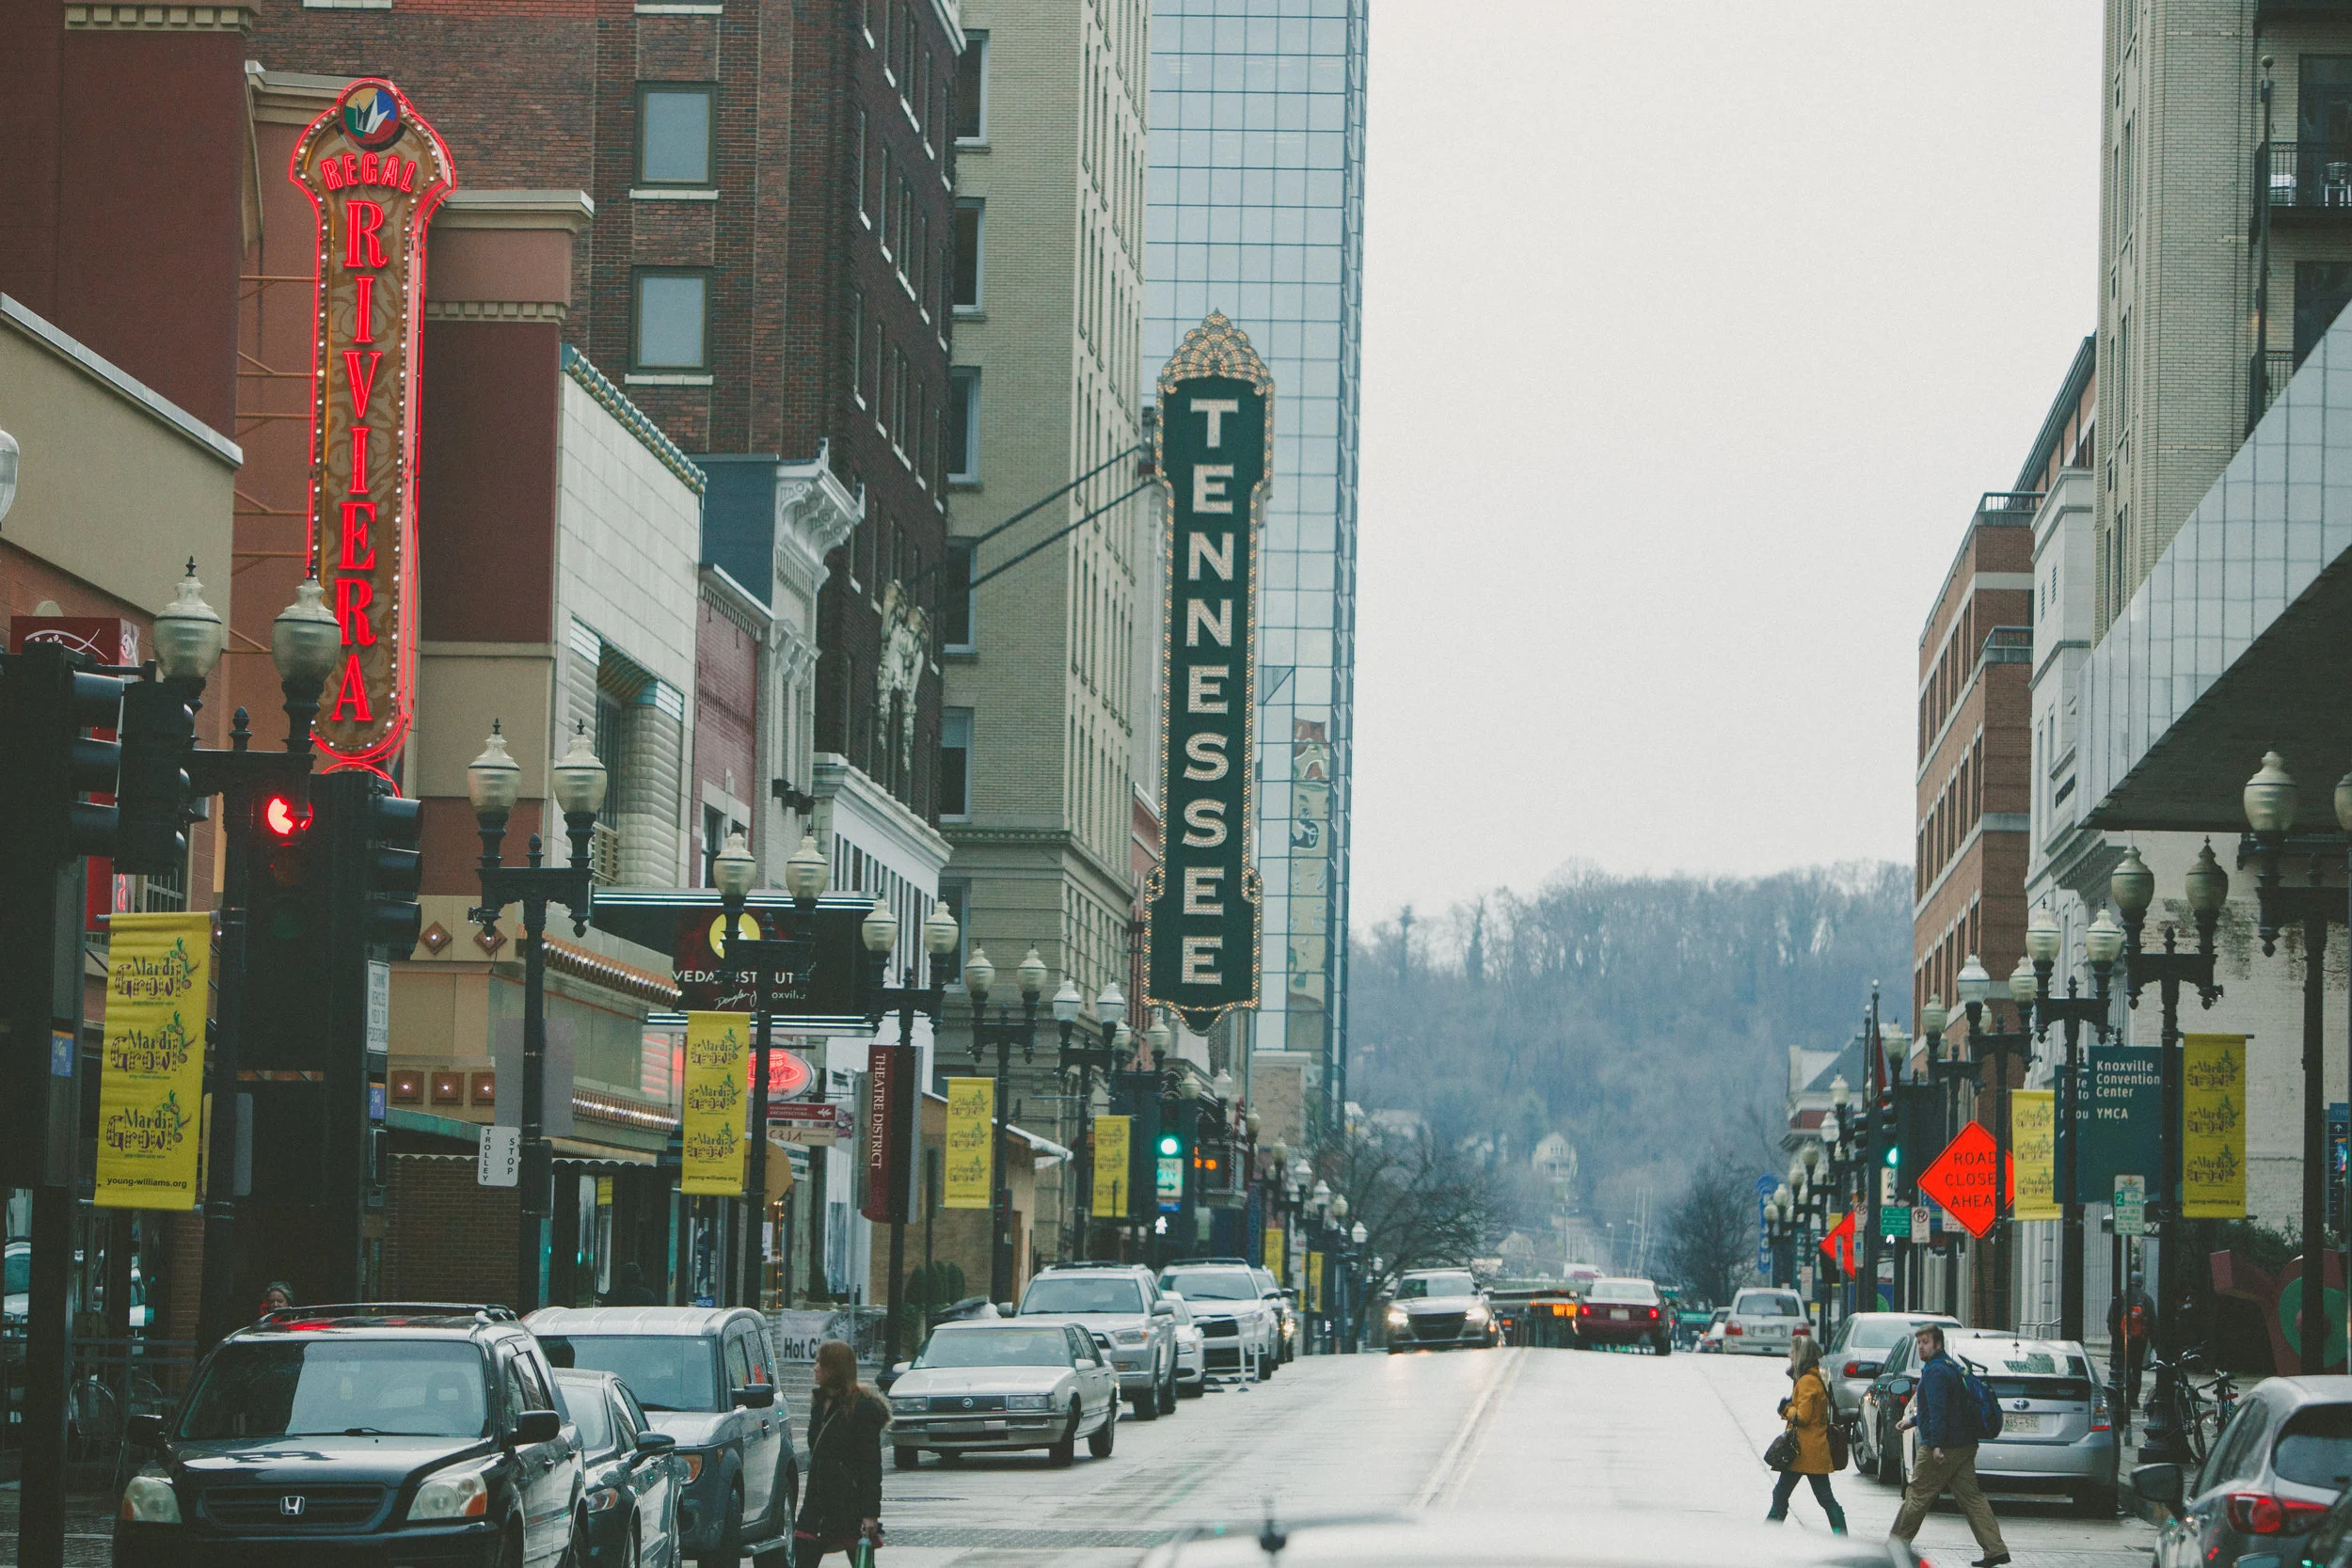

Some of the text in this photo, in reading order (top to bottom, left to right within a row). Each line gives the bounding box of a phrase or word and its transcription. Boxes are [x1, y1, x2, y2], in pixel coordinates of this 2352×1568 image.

[320, 152, 417, 193] REGAL
[331, 199, 389, 721] RIVIERA
[1182, 398, 1239, 986] TENNESSEE
[133, 956, 175, 976] Mardi
[673, 970, 716, 983] VEDA
[128, 1028, 171, 1050] Mardi
[2096, 1060, 2153, 1072] Knoxville
[2096, 1073, 2161, 1085] Convention
[2096, 1086, 2134, 1098] Center
[871, 1053, 886, 1168] THEATRE DISTRICT
[2096, 1108, 2129, 1119] YMCA
[124, 1107, 167, 1129] Mardi
[483, 1129, 491, 1181] TROLLEY
[1954, 1152, 1996, 1164] ROAD
[106, 1177, 187, 1189] young-williams.org
[1945, 1172, 1996, 1186] CLOSE
[1950, 1195, 1994, 1208] AHEA
[2116, 1193, 2123, 1205] 2
[784, 1338, 805, 1358] Hot
